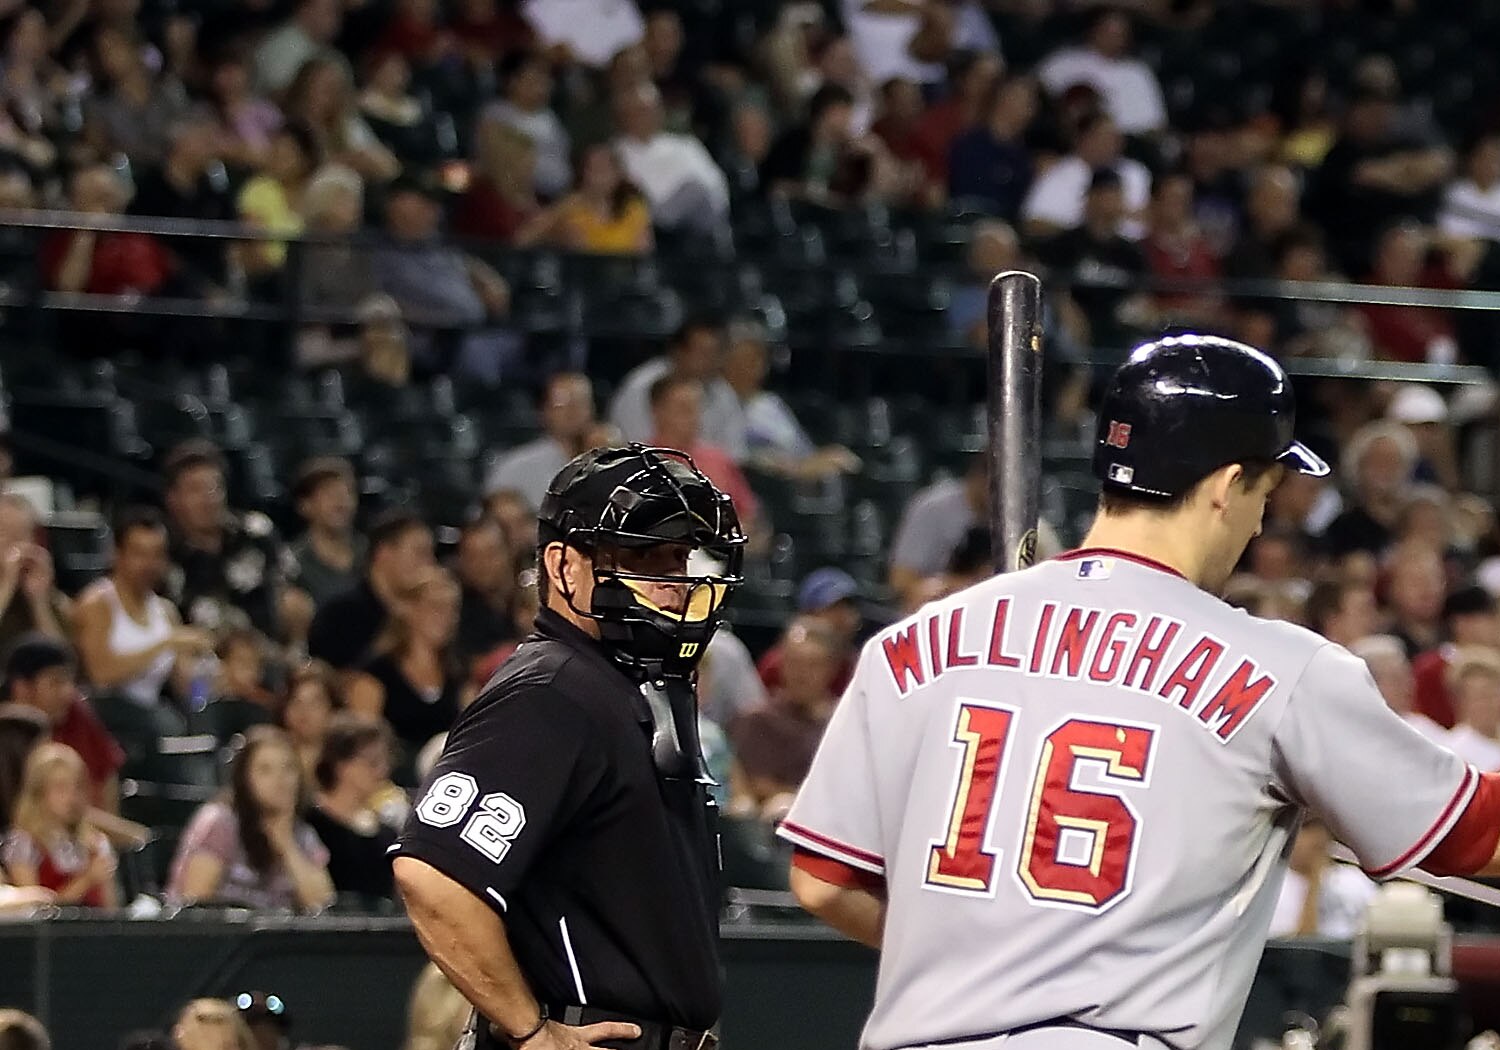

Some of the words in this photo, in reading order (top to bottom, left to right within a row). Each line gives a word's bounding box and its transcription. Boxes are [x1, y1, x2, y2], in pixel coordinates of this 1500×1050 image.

[881, 595, 1279, 745] WILLINGHAM
[416, 771, 527, 864] 82
[921, 697, 1160, 914] 16
